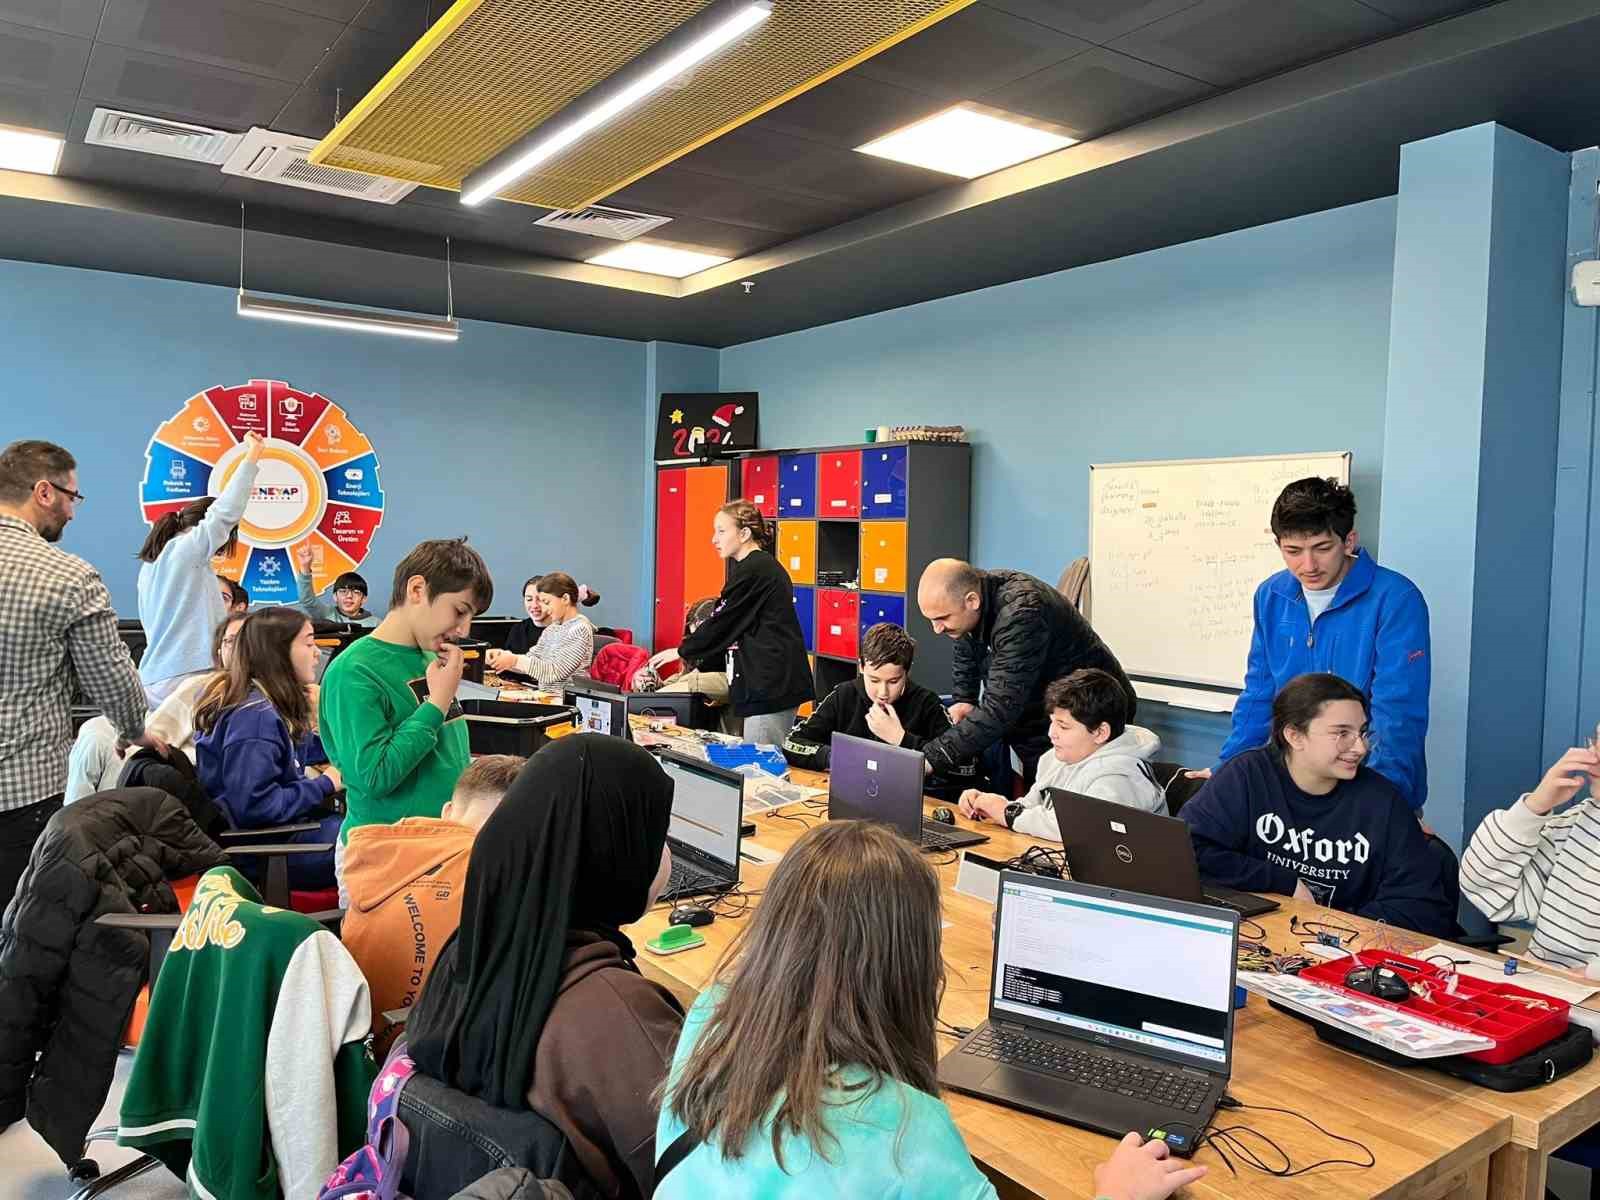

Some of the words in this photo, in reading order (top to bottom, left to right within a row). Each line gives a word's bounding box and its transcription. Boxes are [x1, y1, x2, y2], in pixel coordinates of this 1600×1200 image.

[1256, 812, 1370, 864] Oxford
[1267, 851, 1350, 879] UNIVERSITY
[403, 892, 426, 964] WELCOME
[410, 968, 423, 986] TO
[400, 990, 417, 1008] YO
